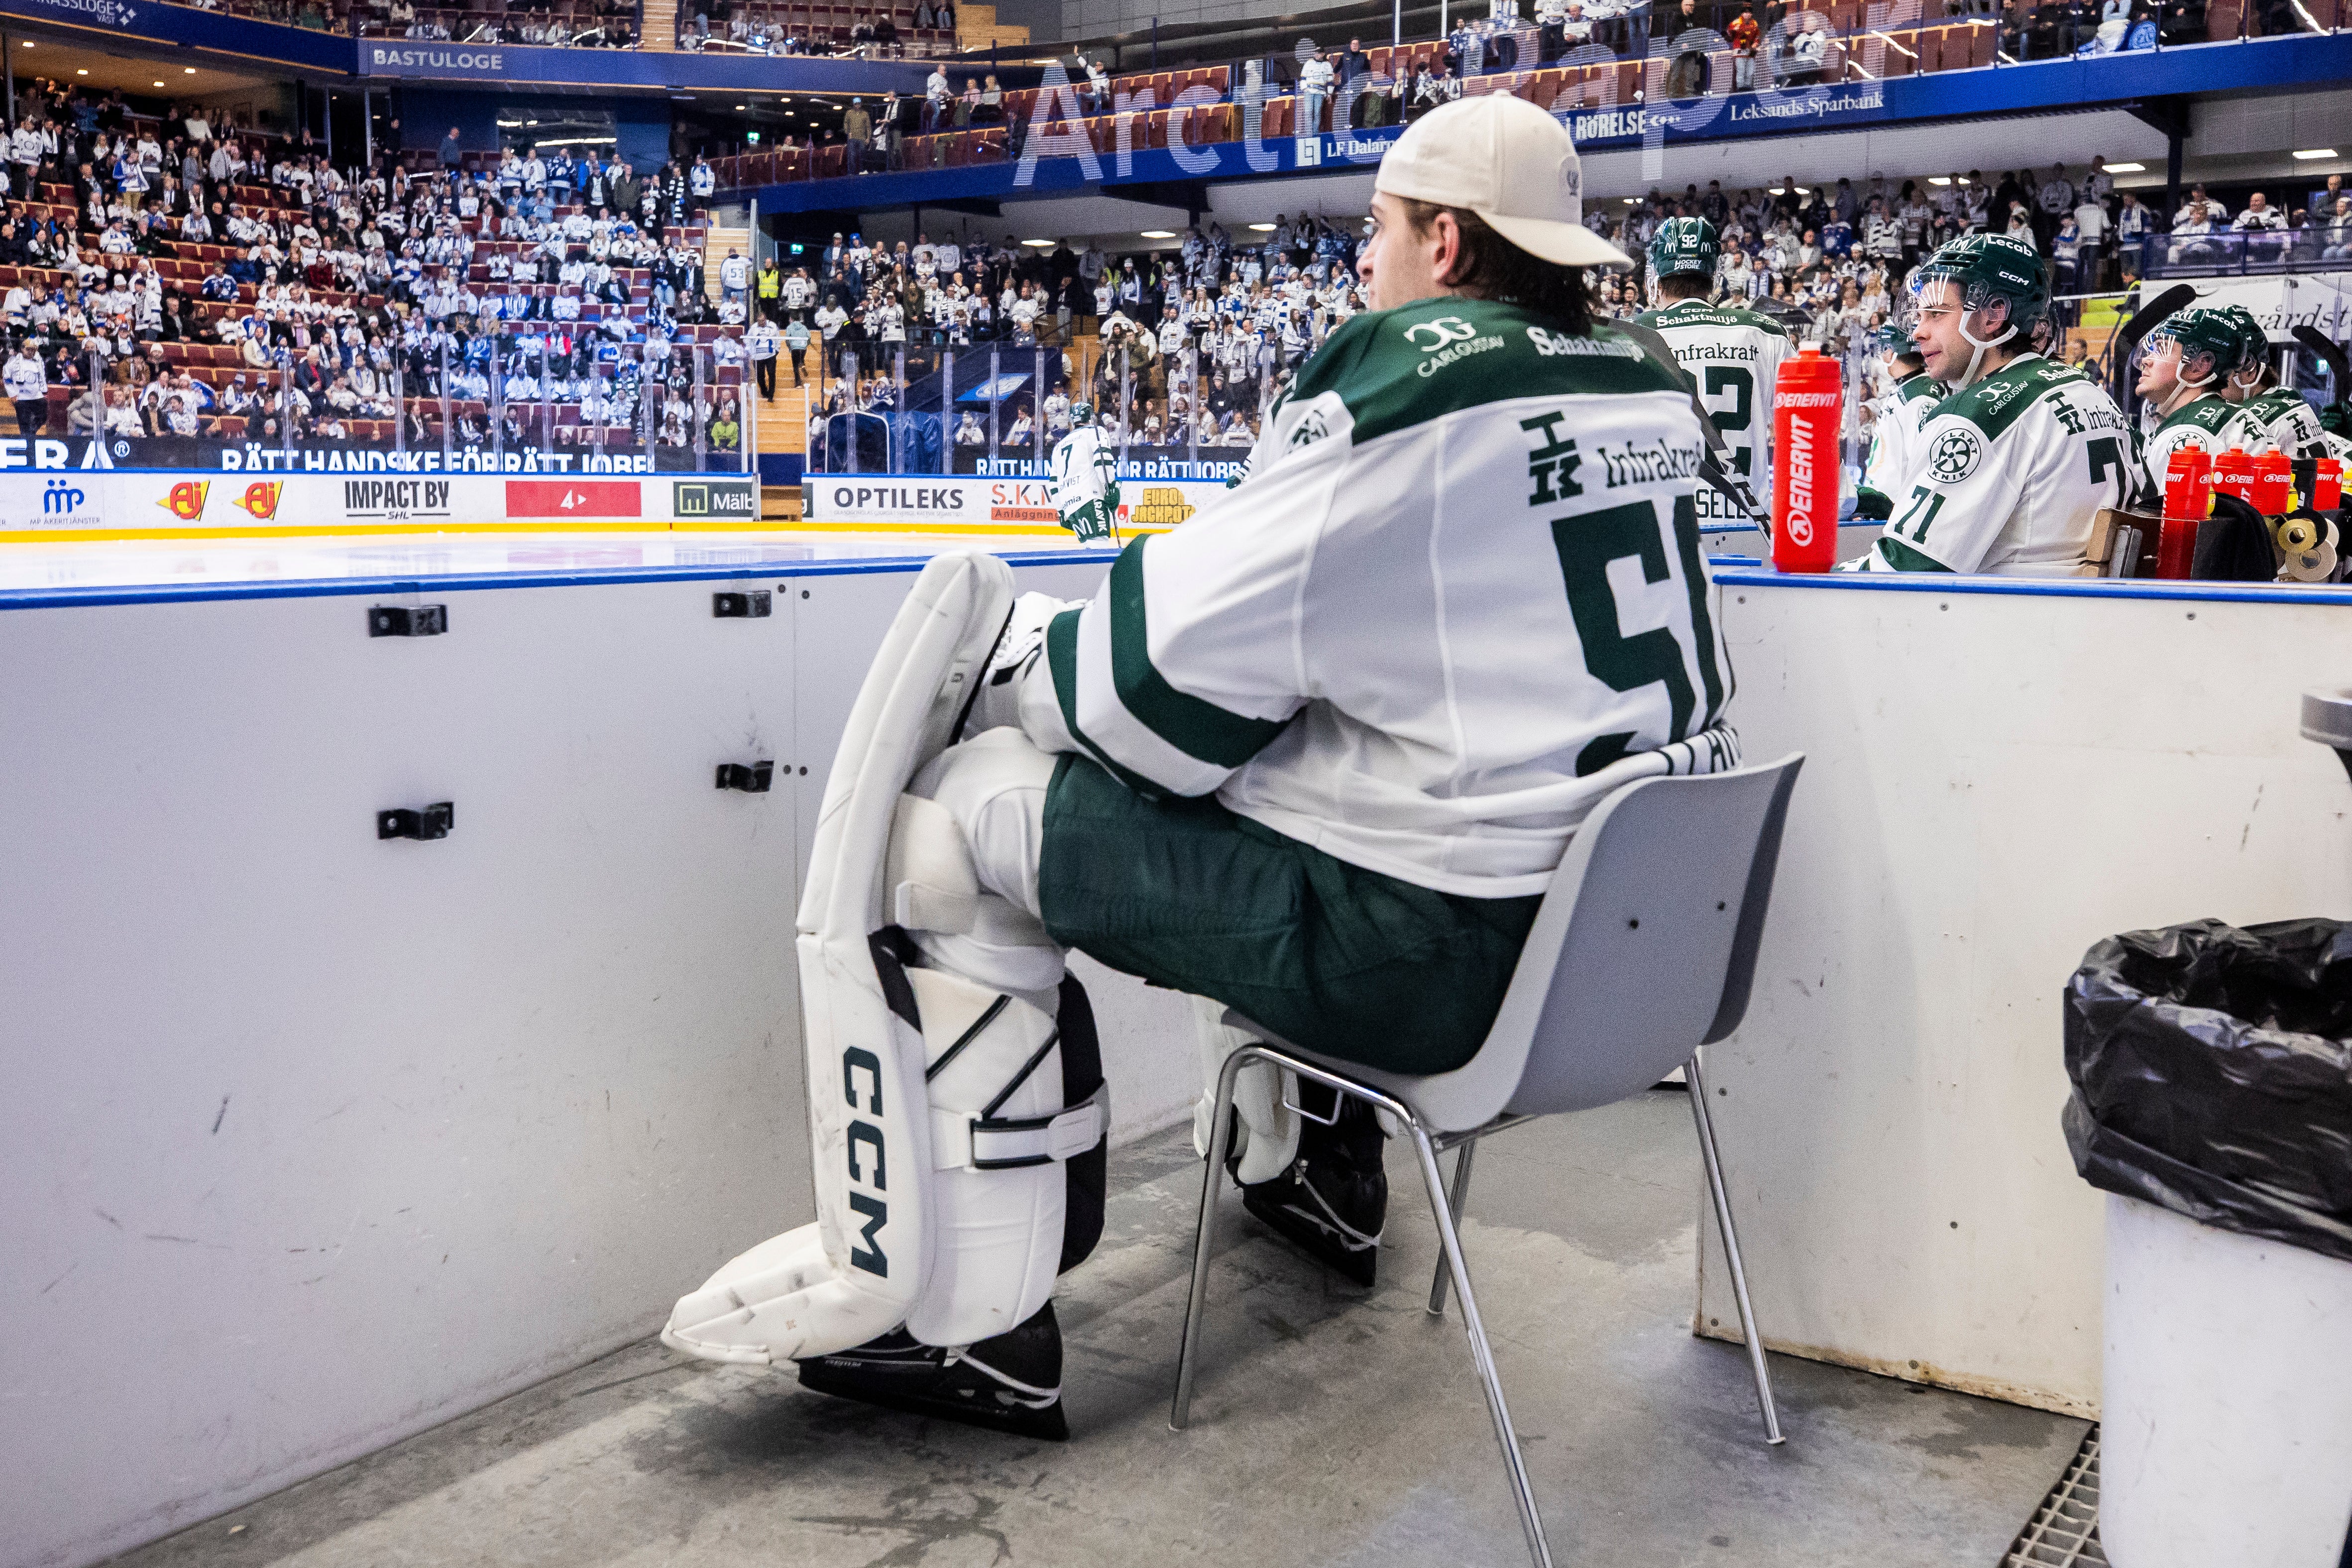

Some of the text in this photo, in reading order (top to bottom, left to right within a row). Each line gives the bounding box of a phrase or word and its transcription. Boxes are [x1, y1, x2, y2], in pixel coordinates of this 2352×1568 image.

[374, 49, 502, 70] BASTULOGE
[1731, 92, 1884, 120] Leksands Sparbank
[1327, 142, 1345, 157] LF
[1682, 234, 1697, 248] 92
[1986, 232, 2032, 257] Lecab
[1675, 259, 1701, 269] HOCKEY
[1999, 271, 2029, 286] CCM
[1656, 314, 1738, 327] Schaktmiljö
[2206, 311, 2237, 331] Lecab
[1788, 392, 1837, 407] ENERVIT
[1704, 366, 1754, 476] 2
[222, 443, 299, 471] RÄTT
[504, 446, 573, 472] RÄTT
[977, 457, 1017, 476] RÄTT
[1145, 456, 1190, 478] RÄTT
[1061, 444, 1073, 479] 7
[1789, 413, 1813, 512] ENERVIT
[345, 480, 449, 509] IMPACT BY
[714, 492, 753, 510] Mälb
[834, 487, 964, 509] OPTILEKS
[1143, 488, 1182, 505] EURO
[388, 510, 409, 520] SHL
[1131, 506, 1195, 523] JACKPOT
[1894, 485, 1946, 545] 71
[843, 1045, 888, 1278] CCM
